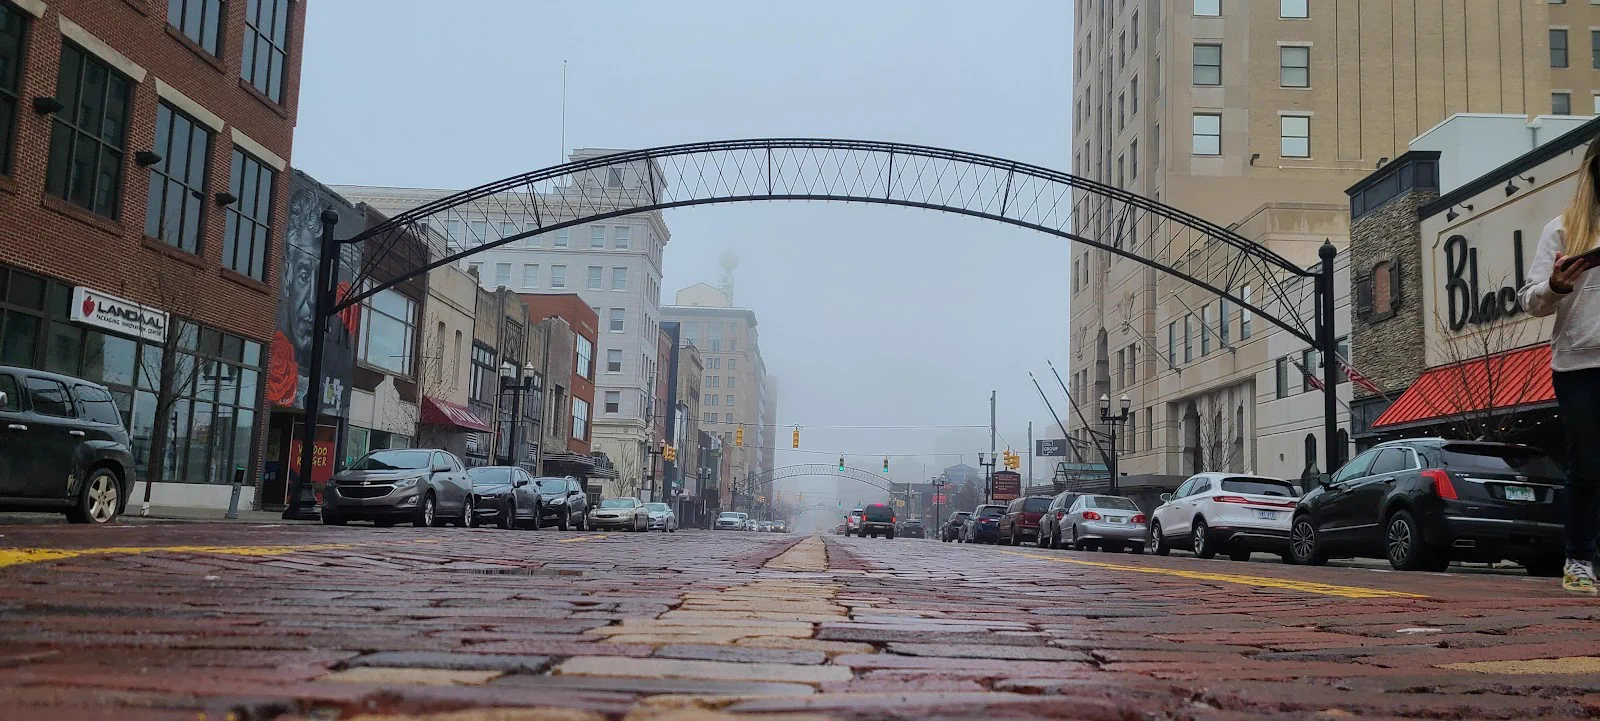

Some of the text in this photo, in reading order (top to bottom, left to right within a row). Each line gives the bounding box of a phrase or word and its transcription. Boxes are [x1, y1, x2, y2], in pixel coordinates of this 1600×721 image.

[95, 314, 120, 325] PACKAGING
[121, 321, 146, 332] INNOVATON
[97, 301, 164, 330] LANDAAL
[297, 443, 328, 456] VDOO
[296, 456, 327, 467] RGER
